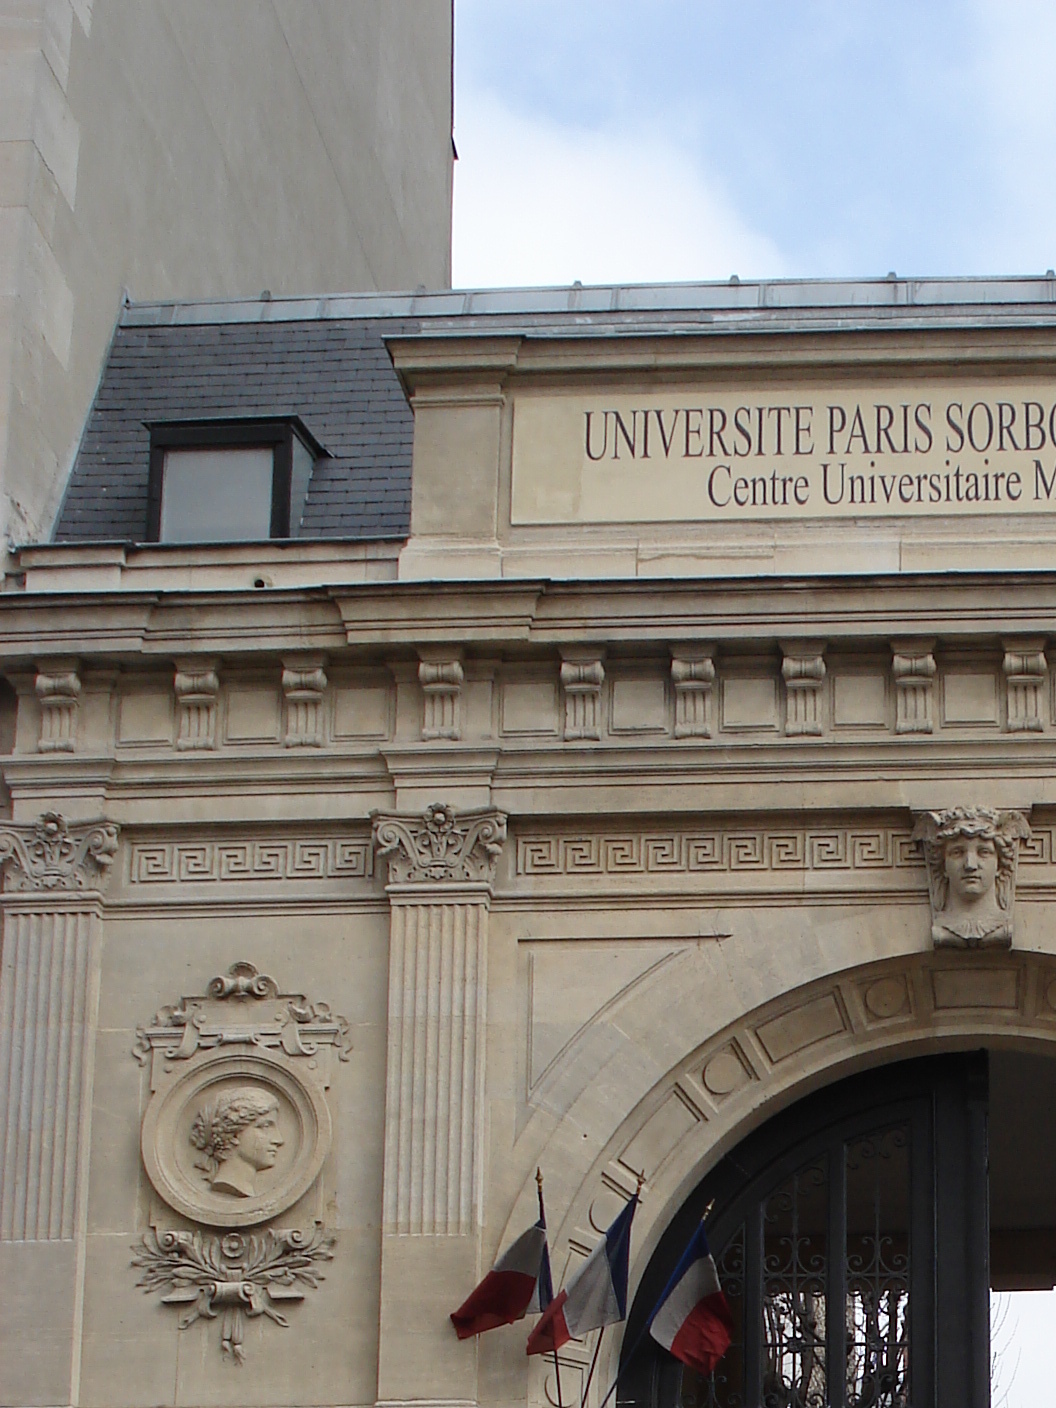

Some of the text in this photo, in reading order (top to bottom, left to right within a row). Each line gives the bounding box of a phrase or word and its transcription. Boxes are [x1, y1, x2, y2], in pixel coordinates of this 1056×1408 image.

[583, 405, 815, 461] UNIVERSITE
[825, 403, 933, 455] PARIS
[707, 464, 811, 507] Centre
[820, 457, 1023, 505] Universitaire
